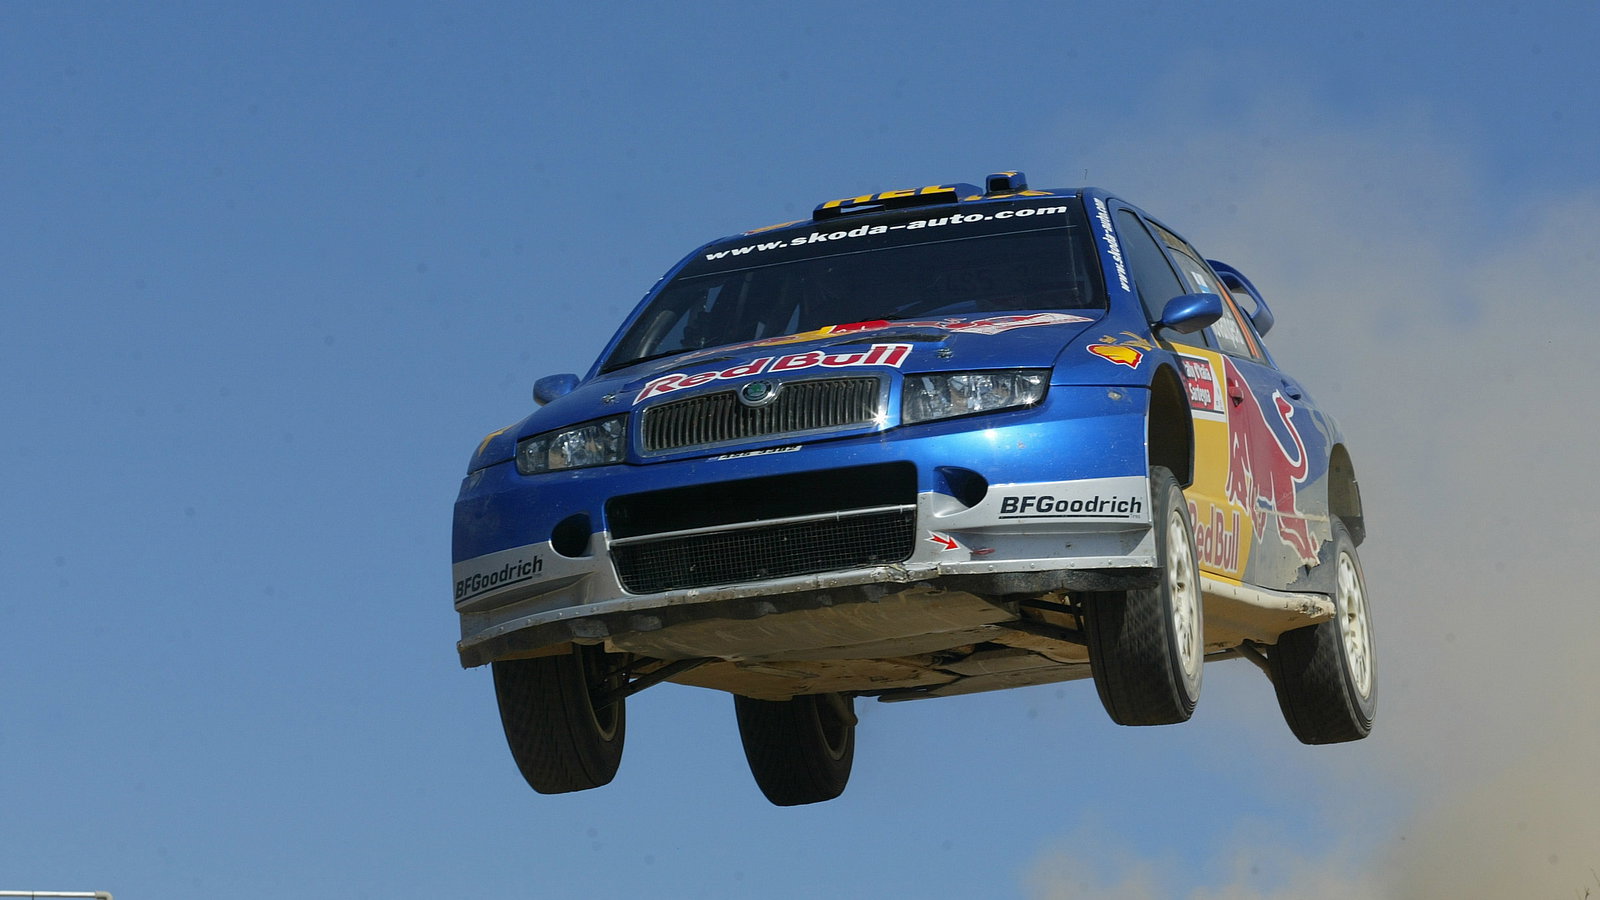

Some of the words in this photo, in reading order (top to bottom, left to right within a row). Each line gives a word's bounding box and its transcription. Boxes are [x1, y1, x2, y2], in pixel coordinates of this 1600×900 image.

[704, 205, 1068, 262] www.skoda-auto.com
[632, 357, 775, 406] Red
[767, 344, 914, 373] Bull
[999, 496, 1142, 514] BFGoodrich
[1213, 507, 1240, 574] Bull
[455, 555, 543, 600] BFGoodrich
